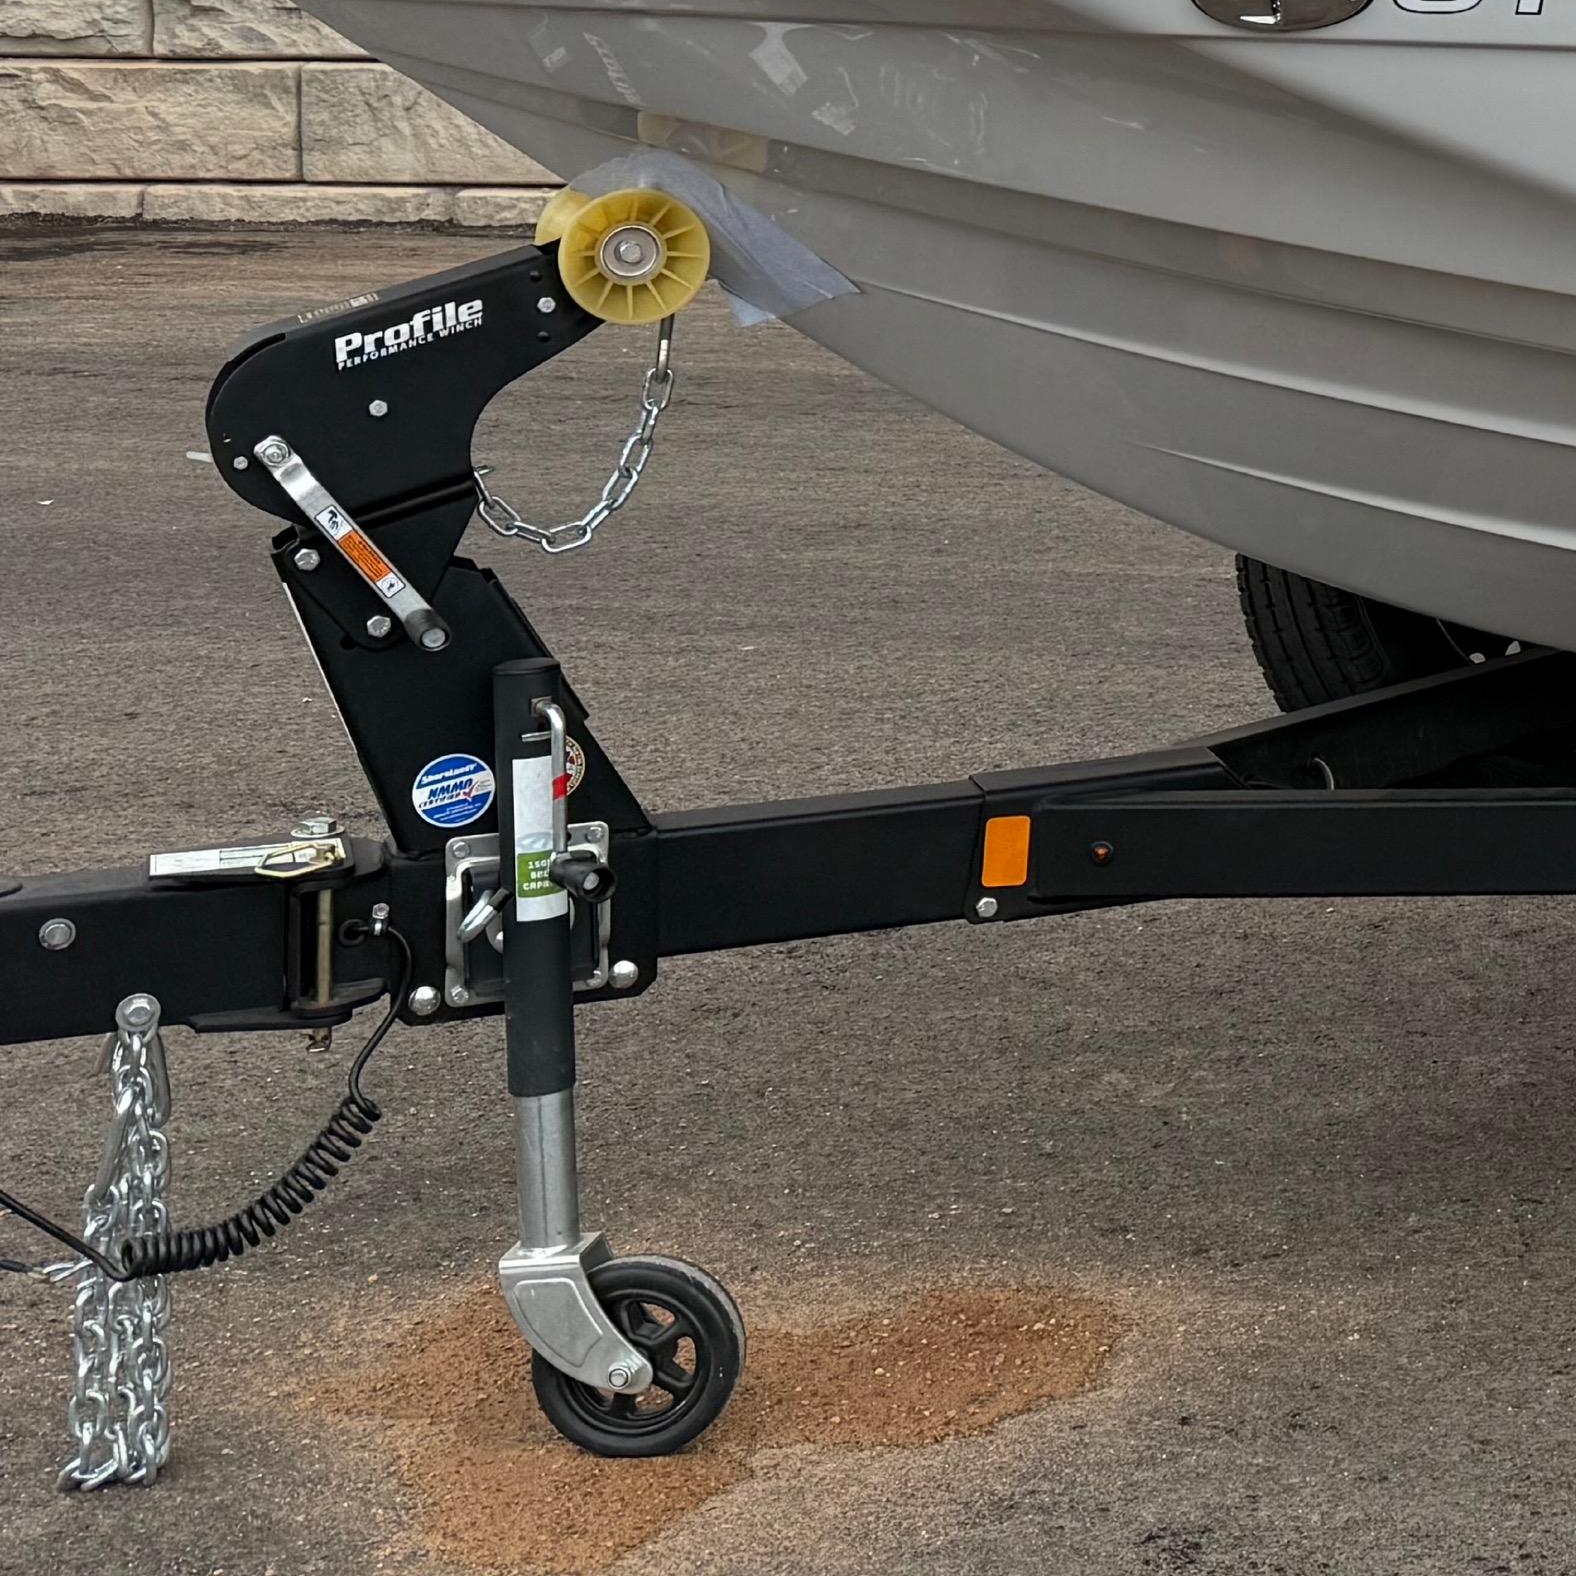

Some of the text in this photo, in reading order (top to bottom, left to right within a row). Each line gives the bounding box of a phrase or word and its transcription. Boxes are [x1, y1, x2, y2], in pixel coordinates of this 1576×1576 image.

[334, 299, 484, 363] Profile
[337, 318, 483, 371] PERFORMANCE WINCH
